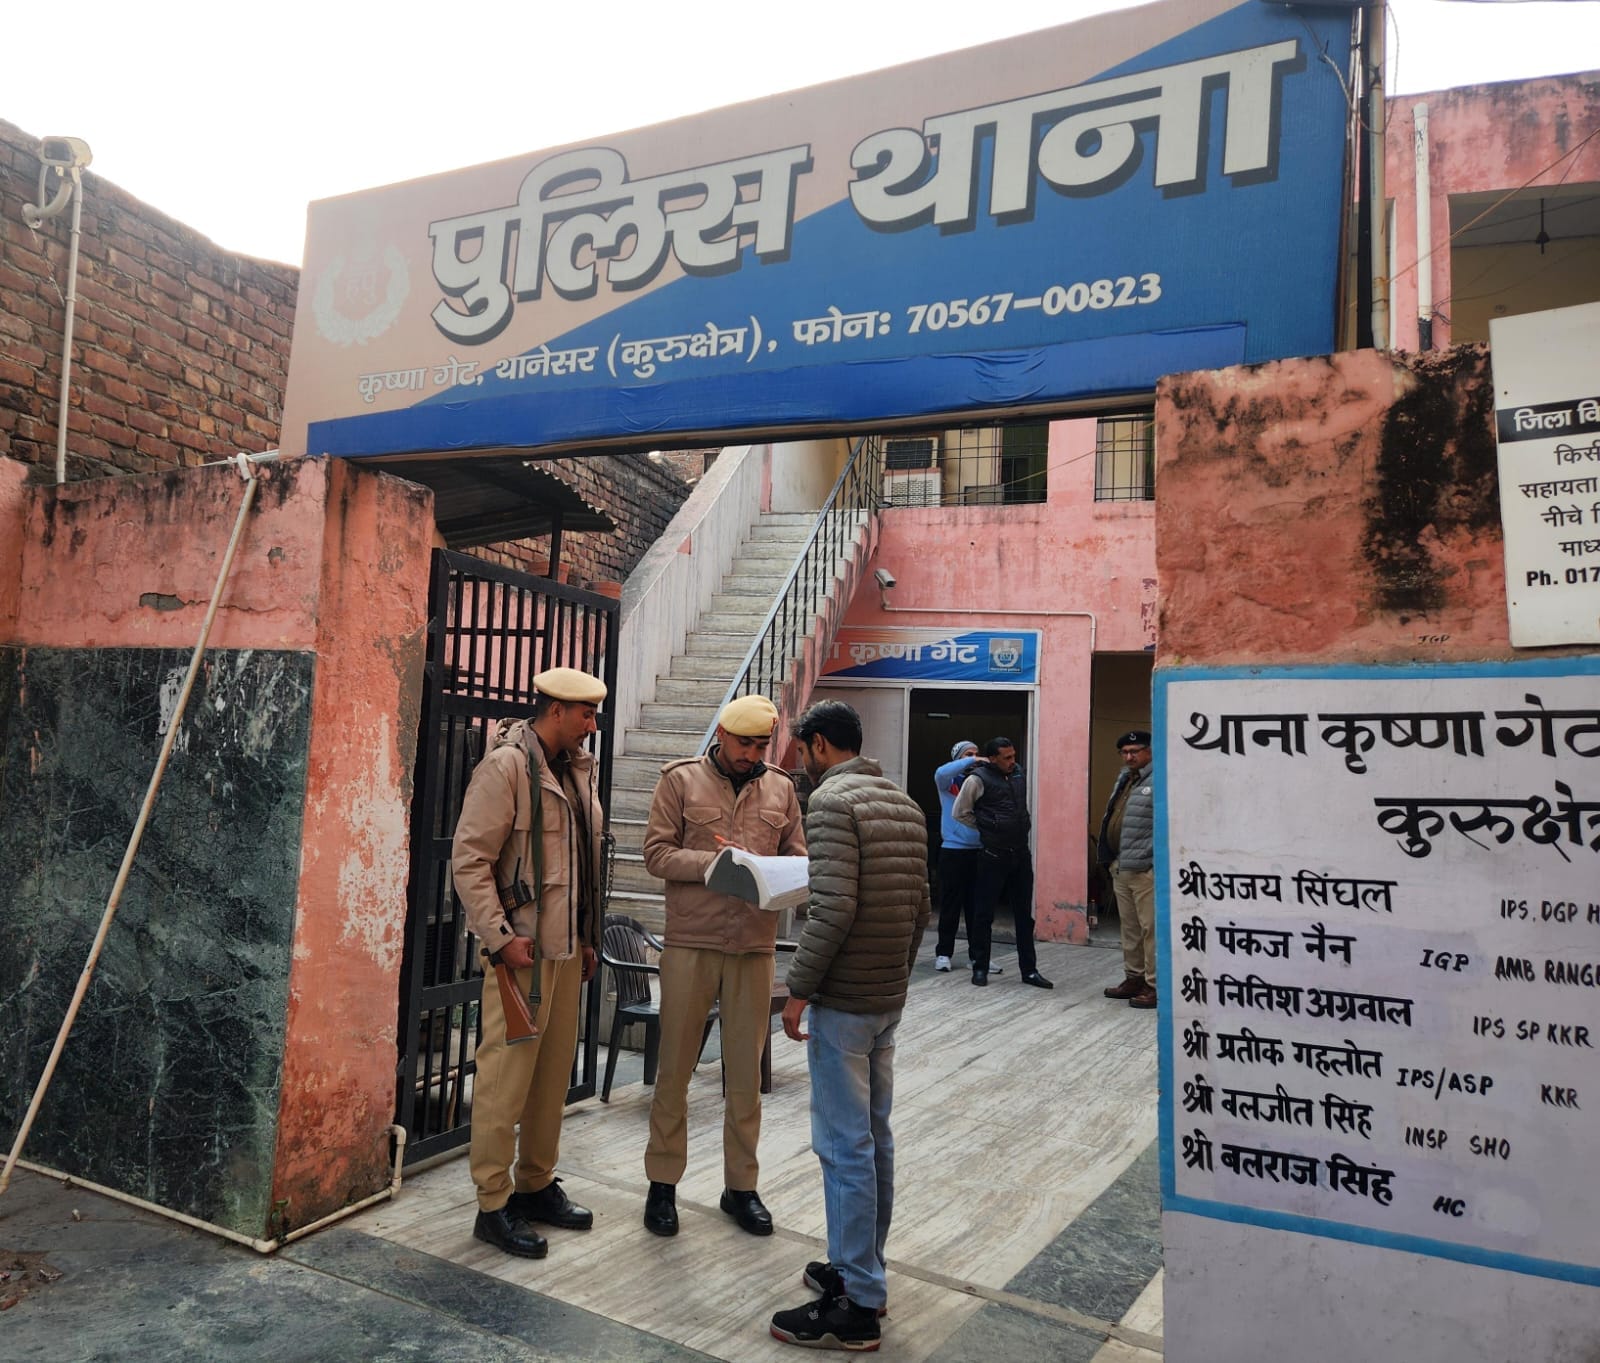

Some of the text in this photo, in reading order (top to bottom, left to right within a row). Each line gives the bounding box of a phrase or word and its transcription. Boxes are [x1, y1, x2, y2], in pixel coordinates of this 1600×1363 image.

[428, 40, 1305, 345] पुलिस थाना
[358, 368, 427, 403] कृष्णा
[432, 356, 484, 386] गेट,
[496, 345, 600, 380] थानेसर
[908, 273, 1162, 334] 70567-00823
[1514, 408, 1572, 432] जिला
[1519, 477, 1598, 499] सहायता
[1541, 505, 1583, 527] नीचे
[1526, 566, 1600, 587] Ph. 017
[848, 641, 924, 666] कृष्णा
[928, 638, 979, 663] गेट
[1182, 711, 1307, 757] थाना
[1319, 711, 1484, 774] कृष्णा
[1292, 869, 1398, 913] सिंघल
[1541, 900, 1578, 923] DGP
[1181, 915, 1357, 965] श्री पंकज नैन
[1419, 949, 1469, 972] IGP
[1494, 955, 1535, 982] AMB
[1181, 967, 1414, 1028] श्री नितिश अग्रवाल
[1182, 1020, 1384, 1079] श्री प्रतीक गहलोत
[1473, 1015, 1594, 1049] IPS SP KKR
[1182, 1073, 1214, 1115] श्री
[1319, 1093, 1374, 1140] सिंह
[1396, 1067, 1581, 1110] IPS/ASP KKR
[1405, 1126, 1511, 1160] INSP SHO
[1182, 1128, 1397, 1207] श्री बलराज सिंह
[1433, 1195, 1466, 1217] HC
